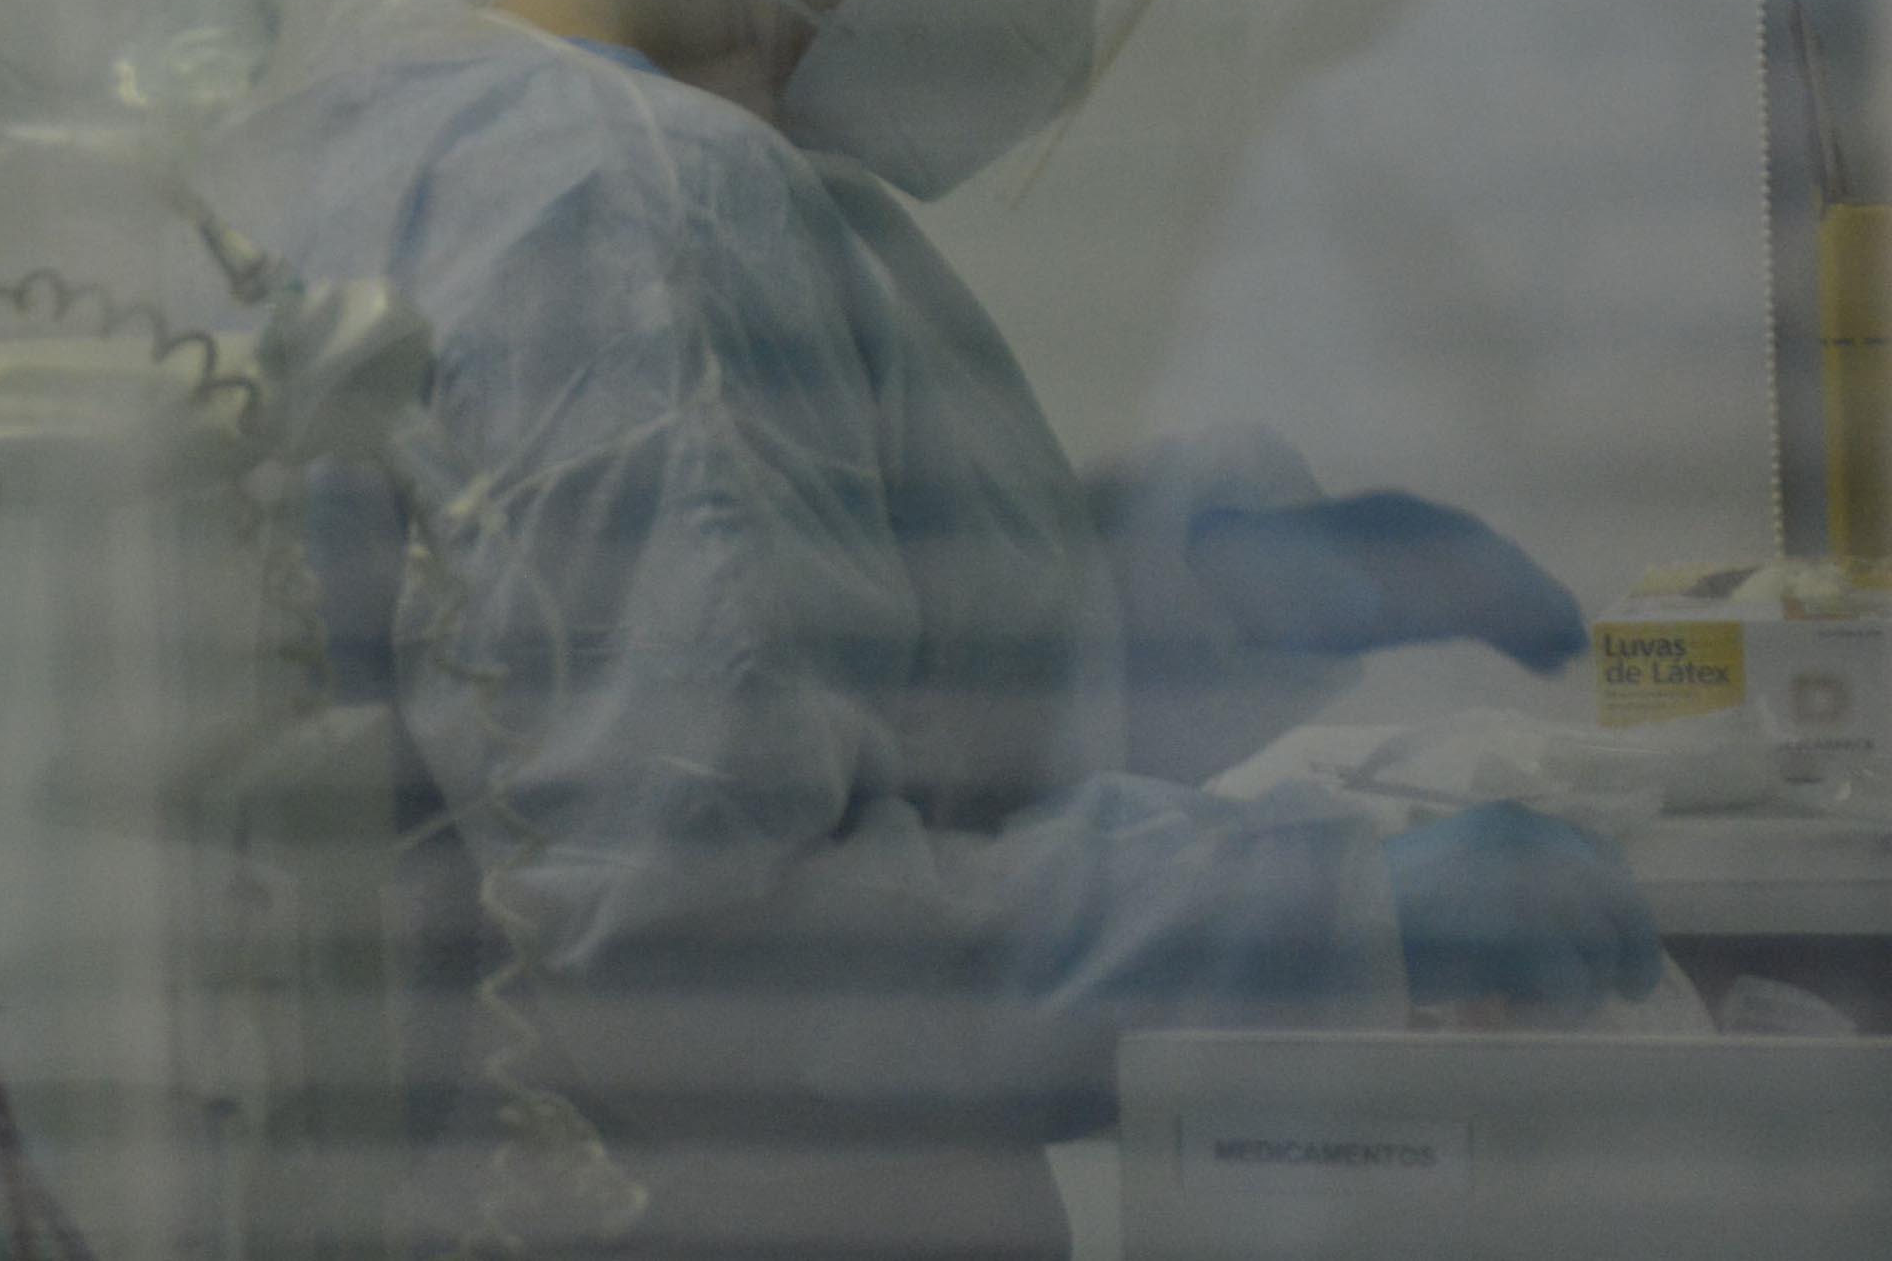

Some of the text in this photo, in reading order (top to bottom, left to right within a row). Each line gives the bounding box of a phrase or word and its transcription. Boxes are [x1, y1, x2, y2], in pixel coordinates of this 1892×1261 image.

[1603, 632, 1687, 658] Luvas
[1605, 660, 1642, 685] de
[1213, 1137, 1437, 1168] MEDICAMENTOS
